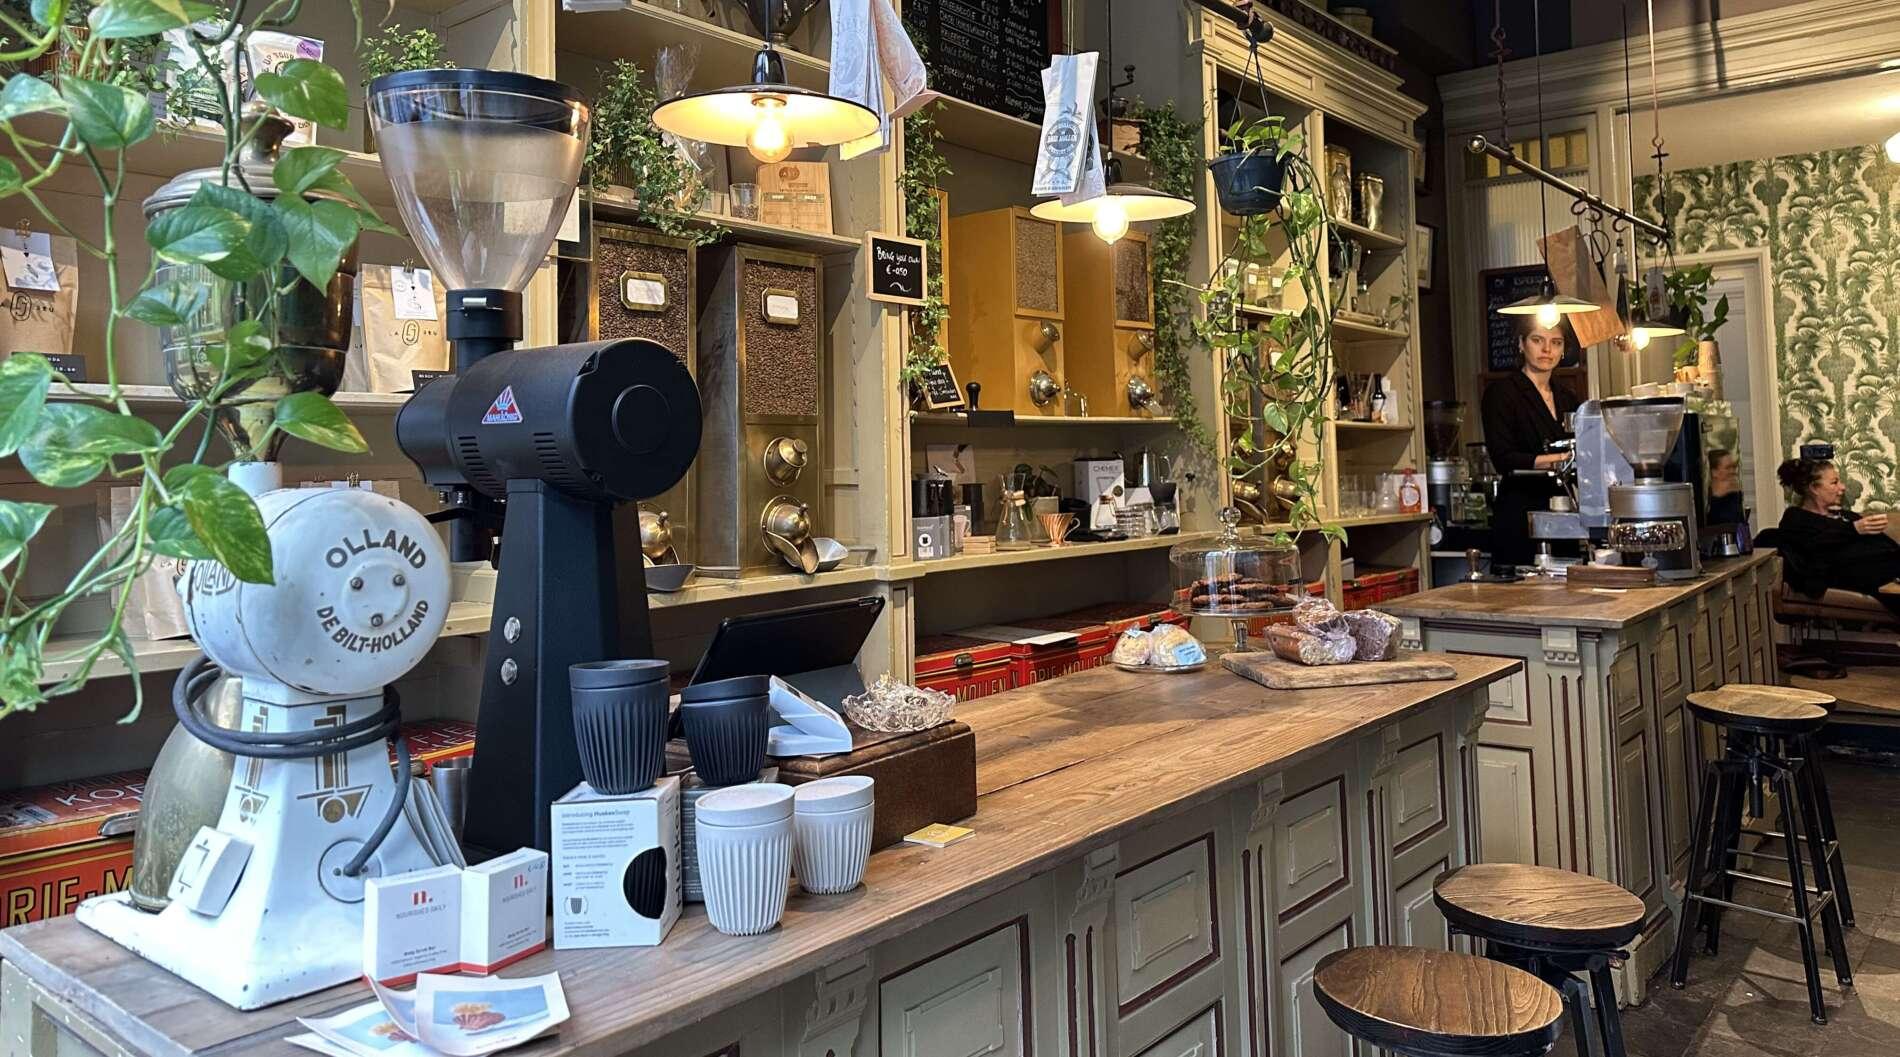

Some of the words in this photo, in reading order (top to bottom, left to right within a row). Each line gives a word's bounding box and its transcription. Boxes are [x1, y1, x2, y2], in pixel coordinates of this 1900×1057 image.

[325, 529, 427, 569] OLLAND
[316, 605, 341, 633] DE
[331, 599, 429, 654] BILT-HOLLAND
